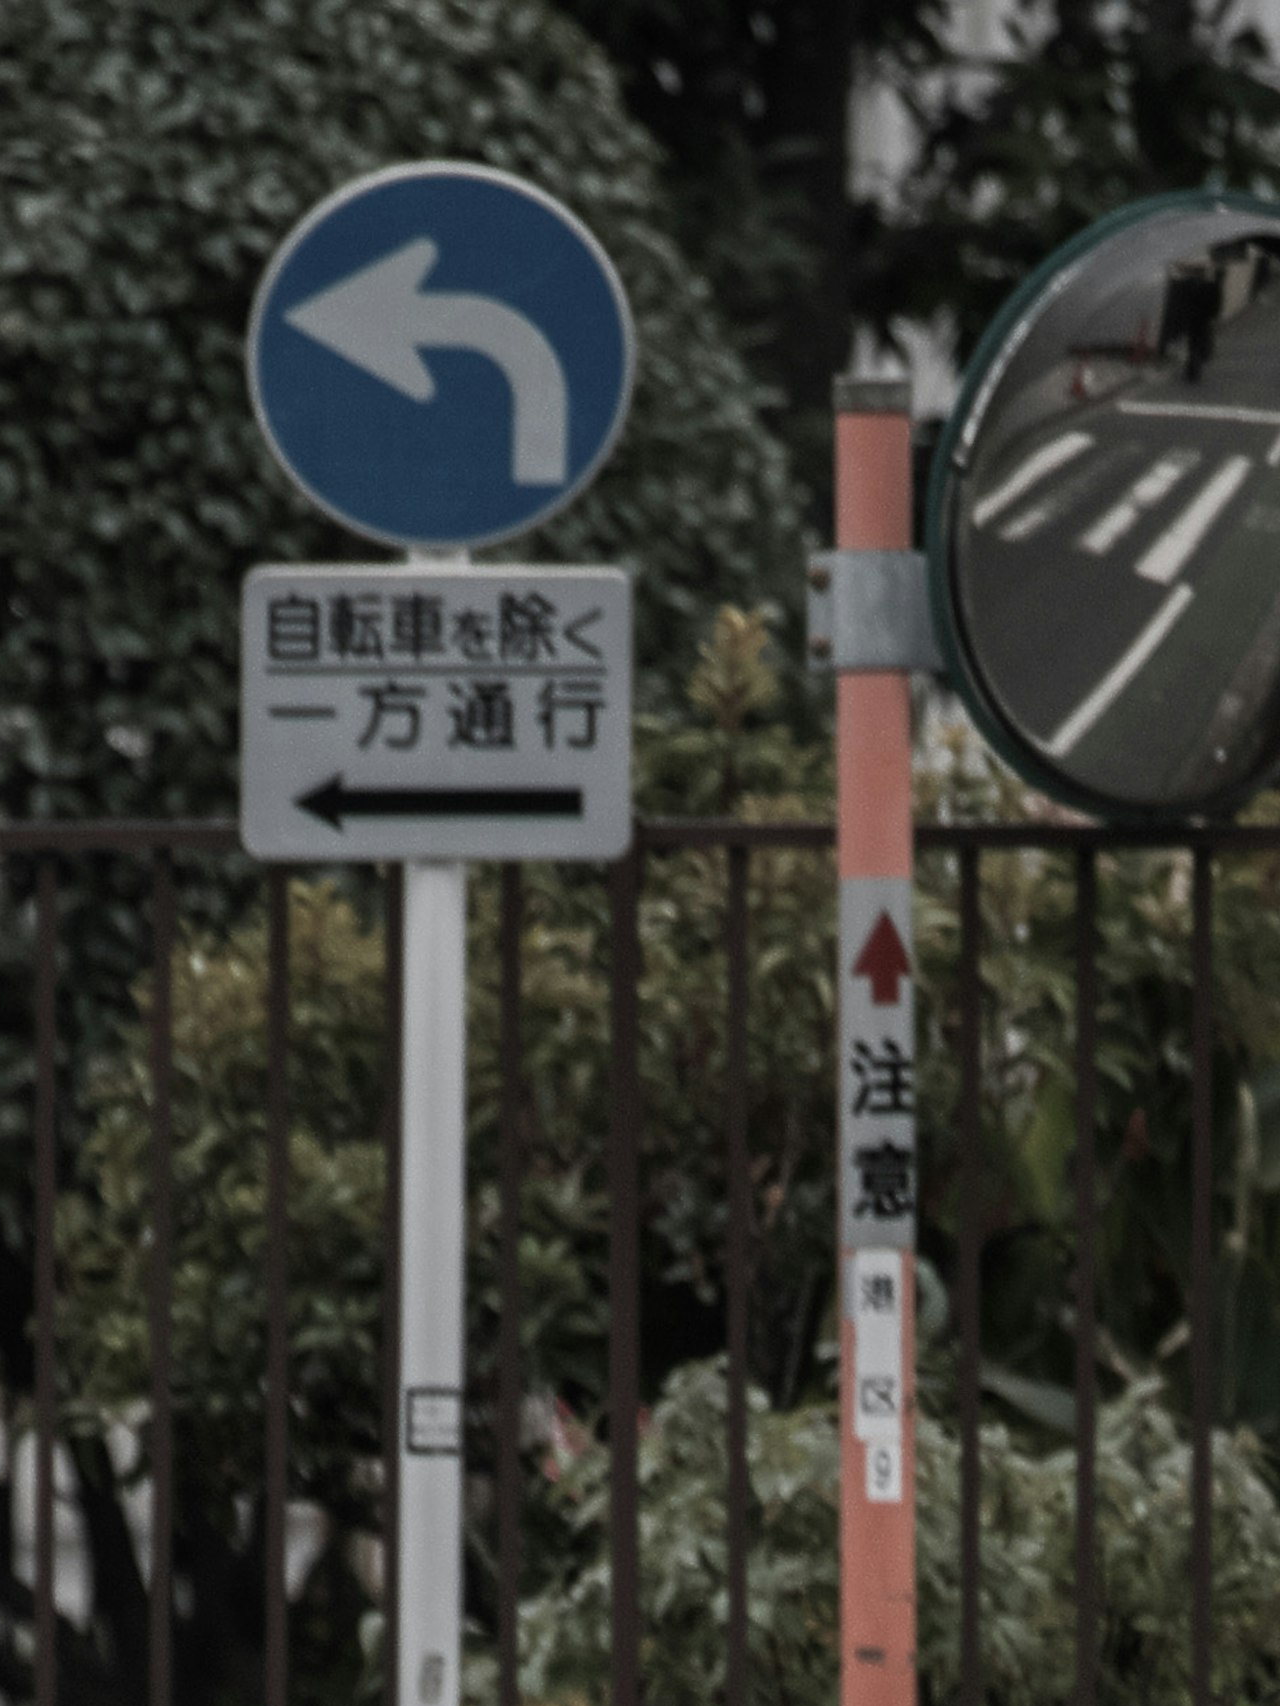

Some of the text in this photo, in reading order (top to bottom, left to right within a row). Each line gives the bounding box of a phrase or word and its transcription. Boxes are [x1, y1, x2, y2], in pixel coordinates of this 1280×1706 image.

[269, 591, 604, 661] 自転車を除く
[269, 680, 606, 750] 一方通行
[851, 1037, 916, 1221] 注意
